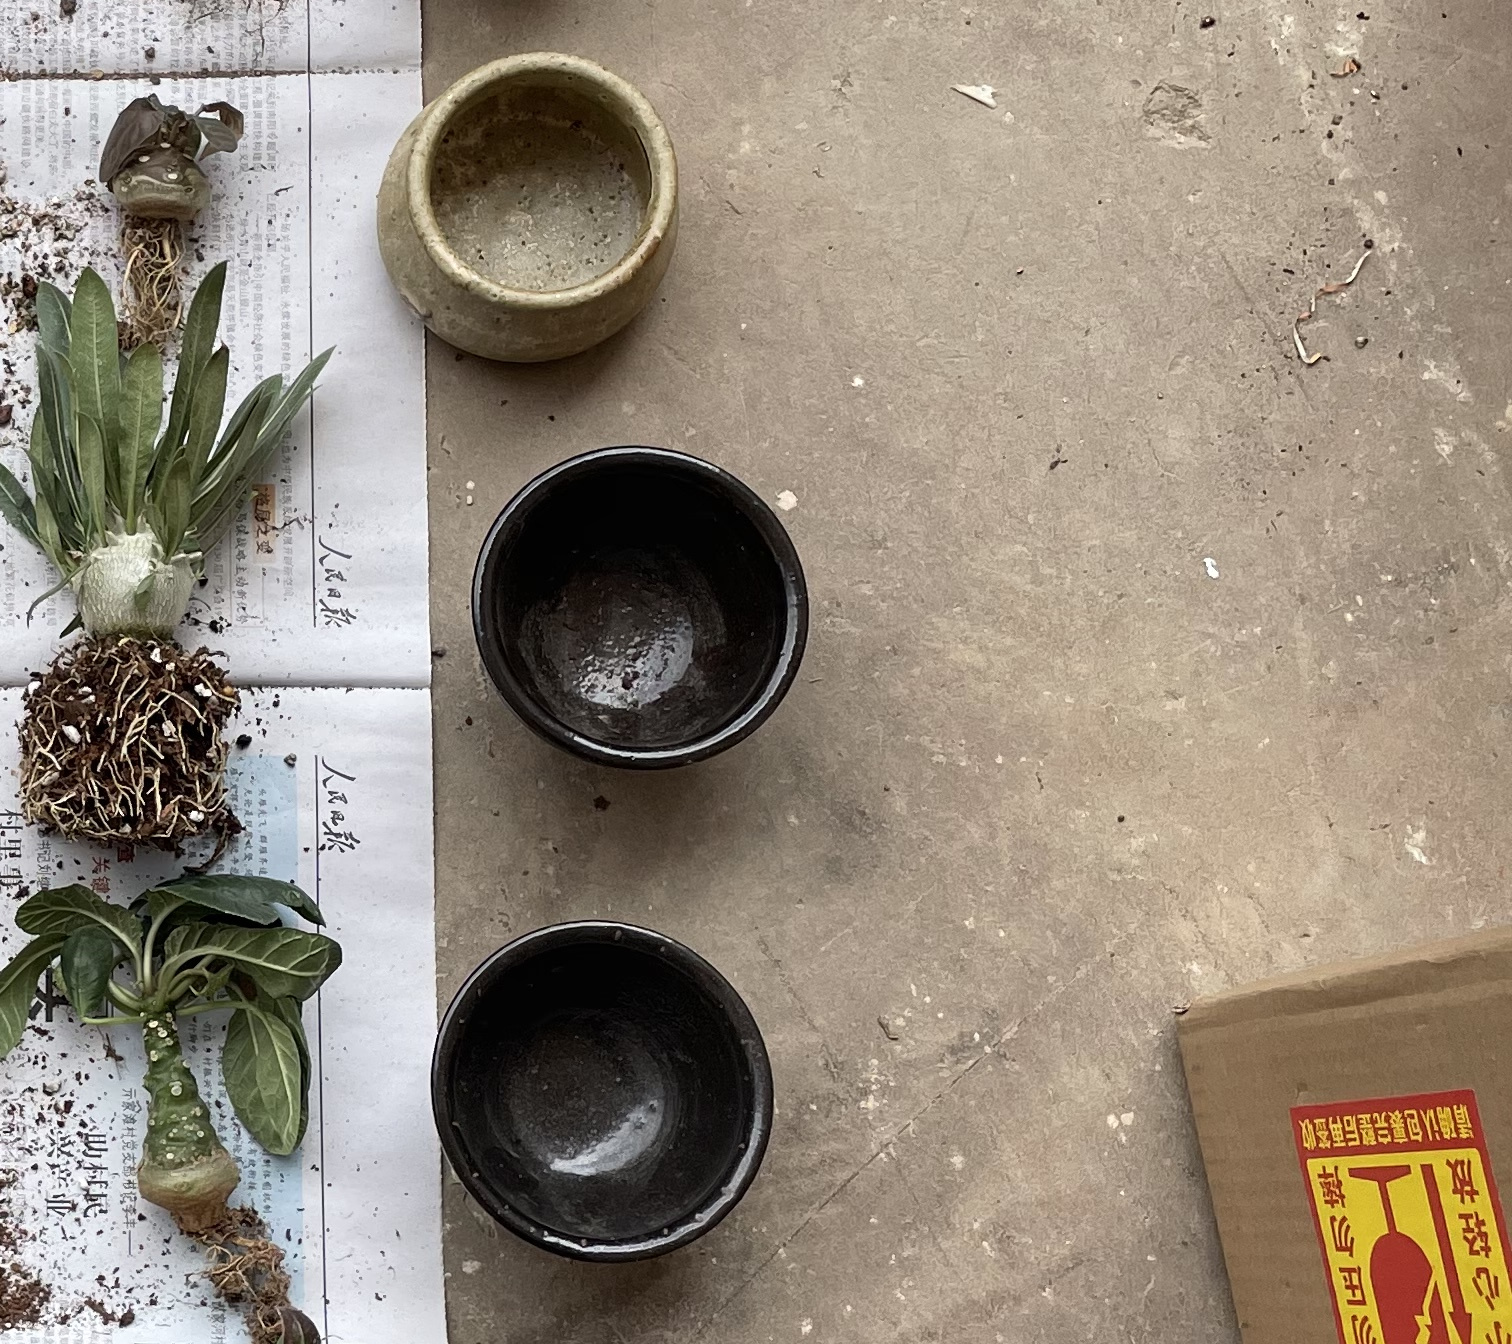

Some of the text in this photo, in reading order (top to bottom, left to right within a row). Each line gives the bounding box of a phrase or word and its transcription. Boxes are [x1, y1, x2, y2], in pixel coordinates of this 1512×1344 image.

[1297, 1102, 1474, 1150] 请确认包裹完整后再签收
